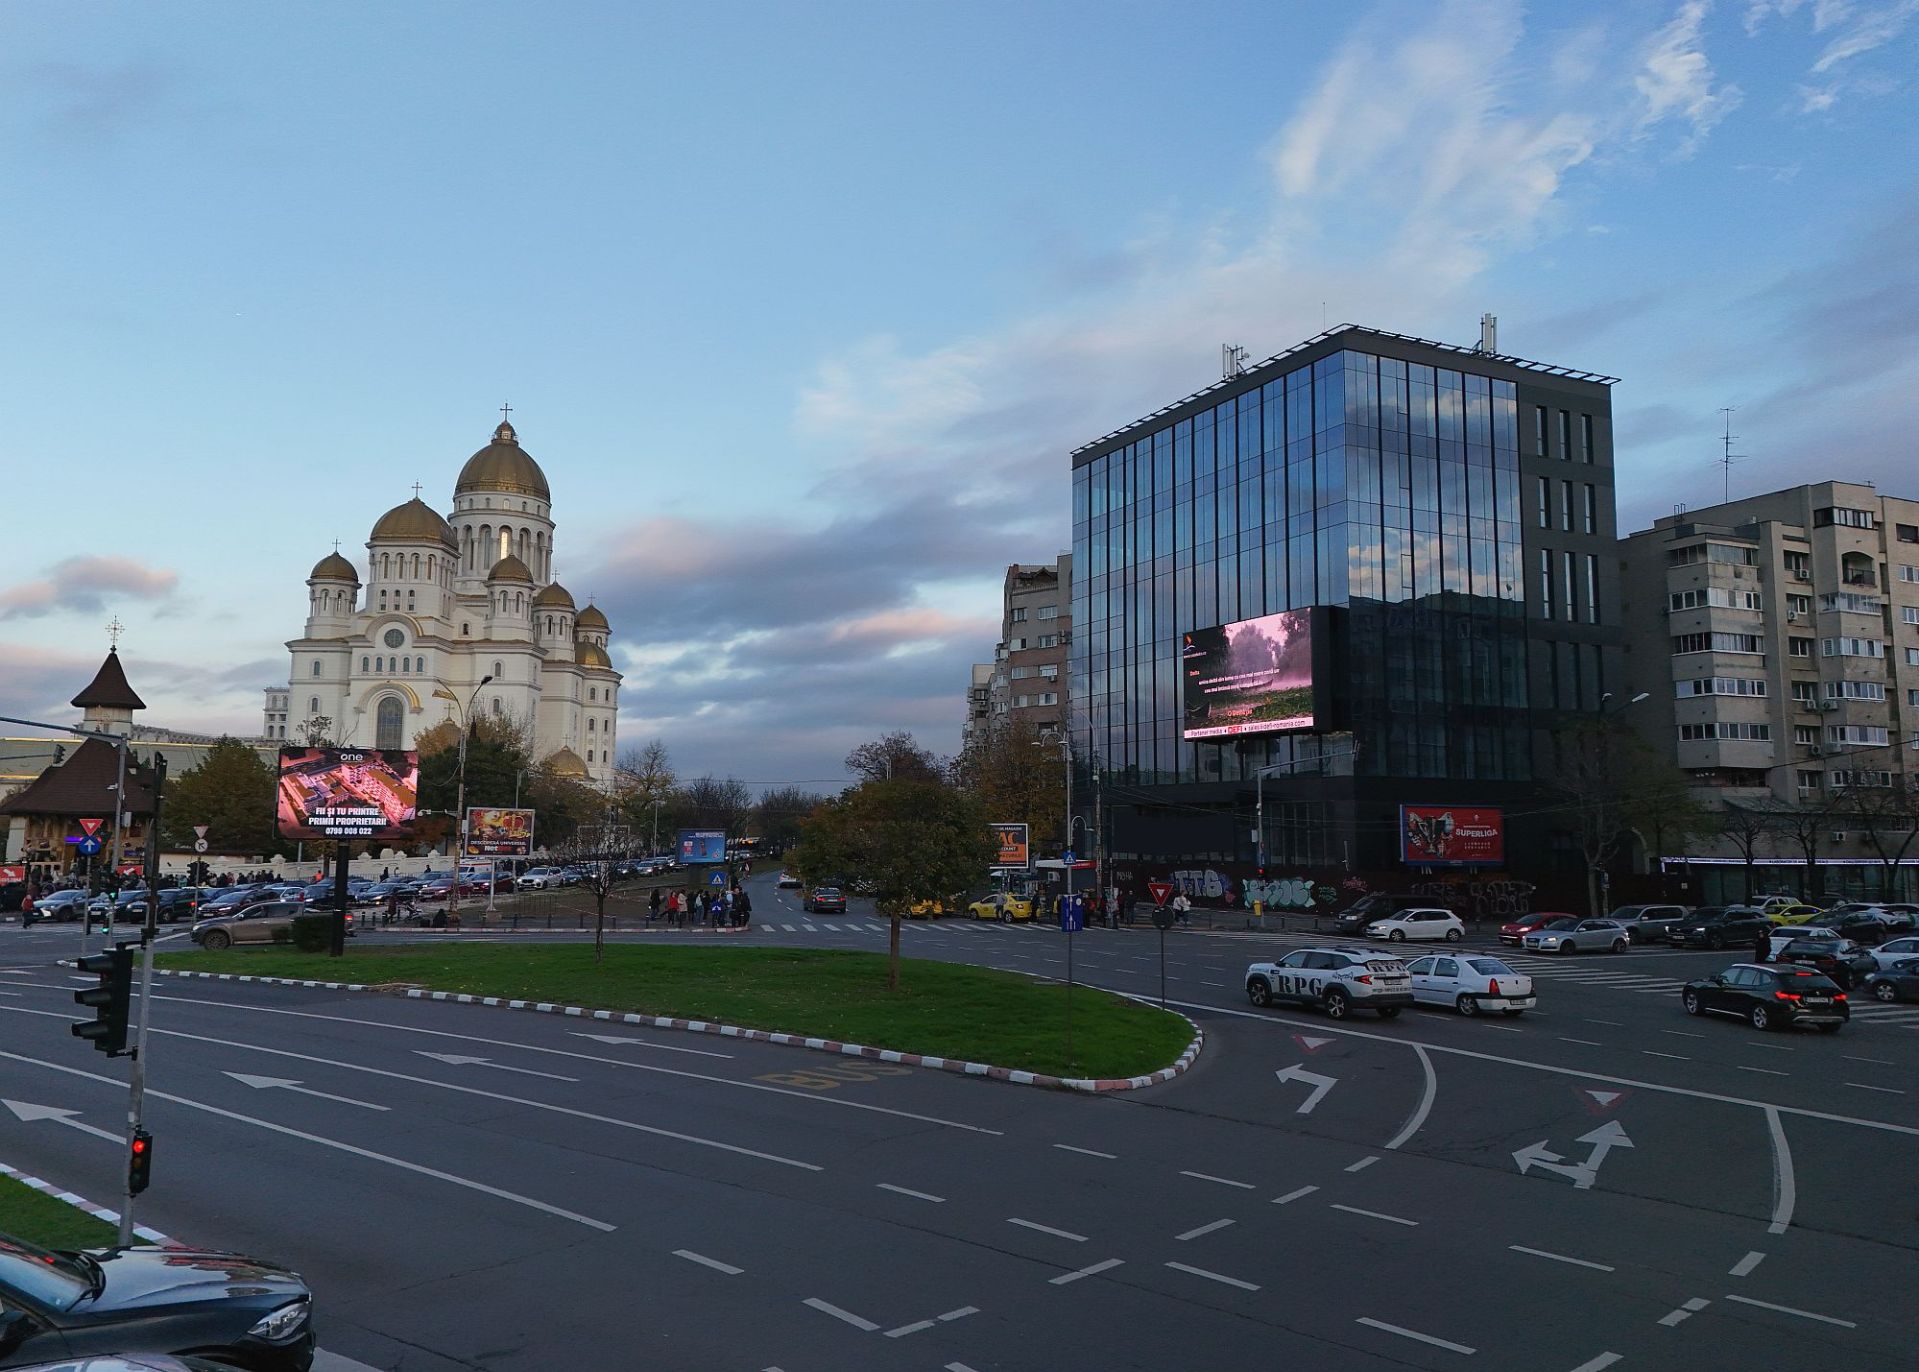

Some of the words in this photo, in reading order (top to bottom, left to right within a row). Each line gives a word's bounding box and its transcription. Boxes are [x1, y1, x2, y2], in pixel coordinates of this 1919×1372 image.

[340, 753, 363, 761] one
[336, 807, 346, 815] TU
[347, 807, 379, 816] PRINTRE
[358, 827, 372, 835] 022
[1455, 828, 1498, 838] SUPERLIGA
[1278, 974, 1322, 998] RPG
[751, 1060, 913, 1091] BUS
